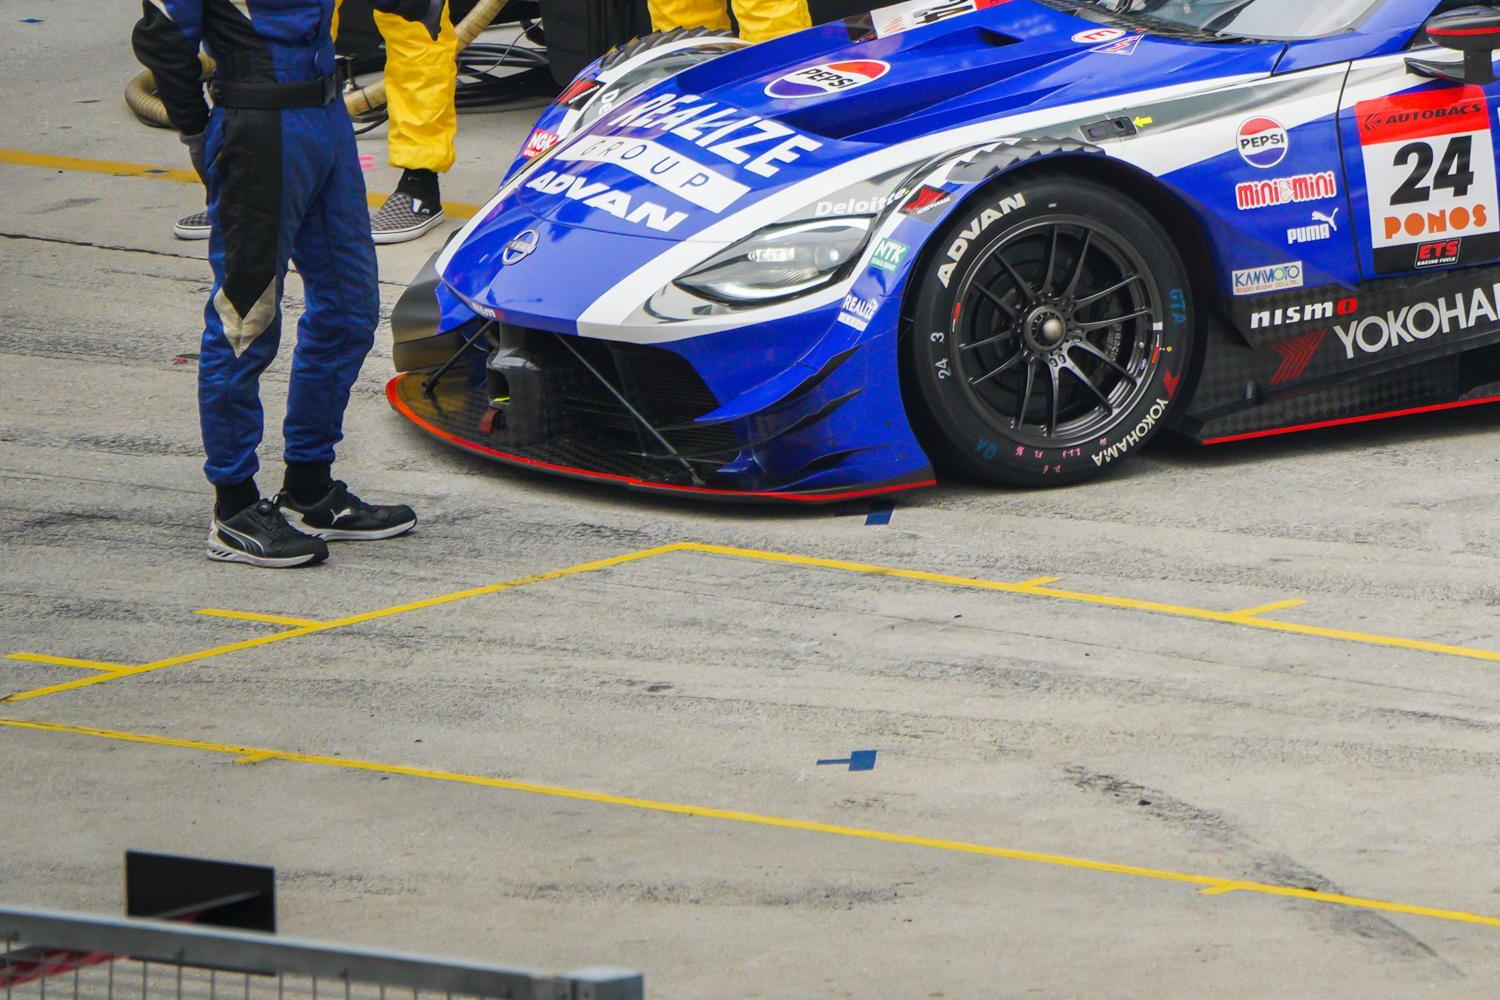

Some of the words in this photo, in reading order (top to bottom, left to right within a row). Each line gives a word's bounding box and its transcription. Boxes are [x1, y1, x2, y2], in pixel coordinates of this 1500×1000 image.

[796, 67, 859, 89] PEPSI
[1385, 102, 1482, 126] AUTOBACS
[607, 92, 824, 178] REALIZE
[1240, 133, 1286, 150] PEPSI
[580, 139, 710, 189] GROUP
[1389, 134, 1475, 207] 24
[526, 170, 689, 233] ADVAN
[1287, 223, 1330, 245] PUMA
[1384, 203, 1488, 240] PONOS
[874, 240, 906, 264] NTK
[937, 193, 1027, 288] ADVAN
[1418, 240, 1460, 260] ETS
[842, 294, 880, 320] REALIZE
[1250, 297, 1358, 329] nismo
[930, 331, 945, 345] 3
[938, 357, 951, 379] 24
[1091, 397, 1170, 467] YOKOHAMA
